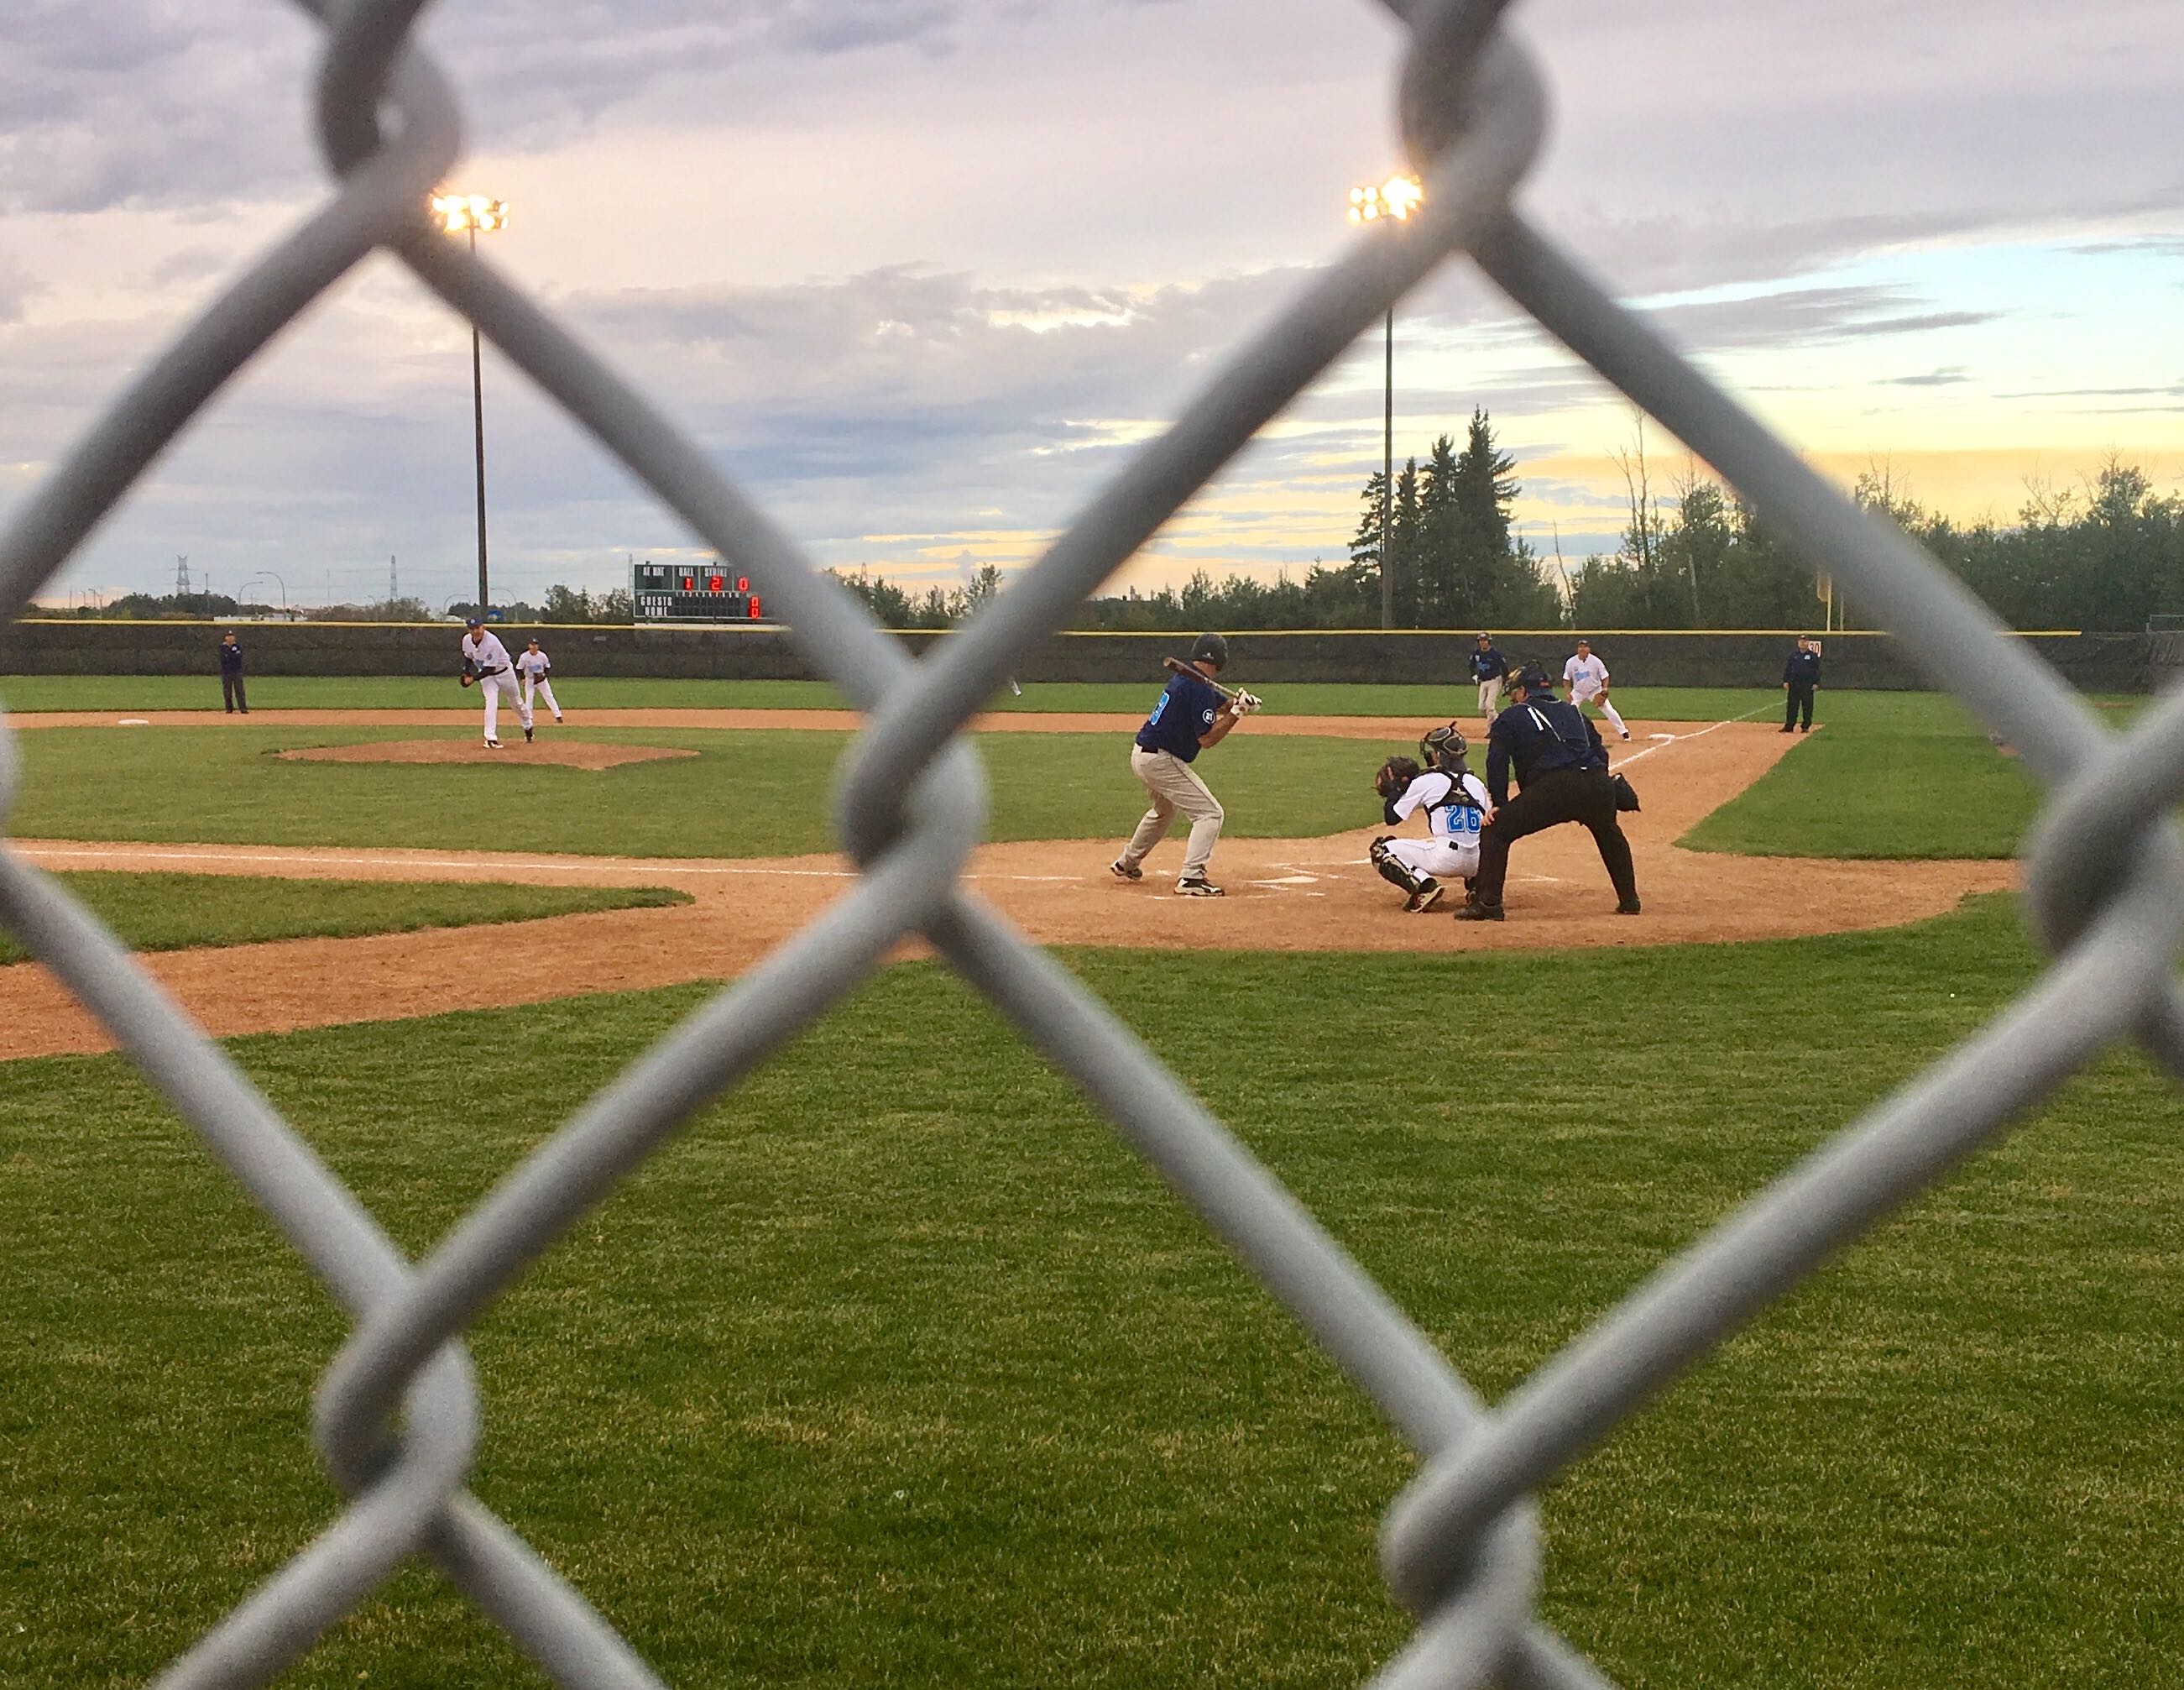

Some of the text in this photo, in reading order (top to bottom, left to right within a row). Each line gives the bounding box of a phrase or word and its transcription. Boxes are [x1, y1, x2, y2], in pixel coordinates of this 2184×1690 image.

[739, 577, 749, 590] 0
[640, 596, 672, 606] GUESTS
[645, 606, 667, 616] HOME
[1445, 805, 1481, 834] 26
